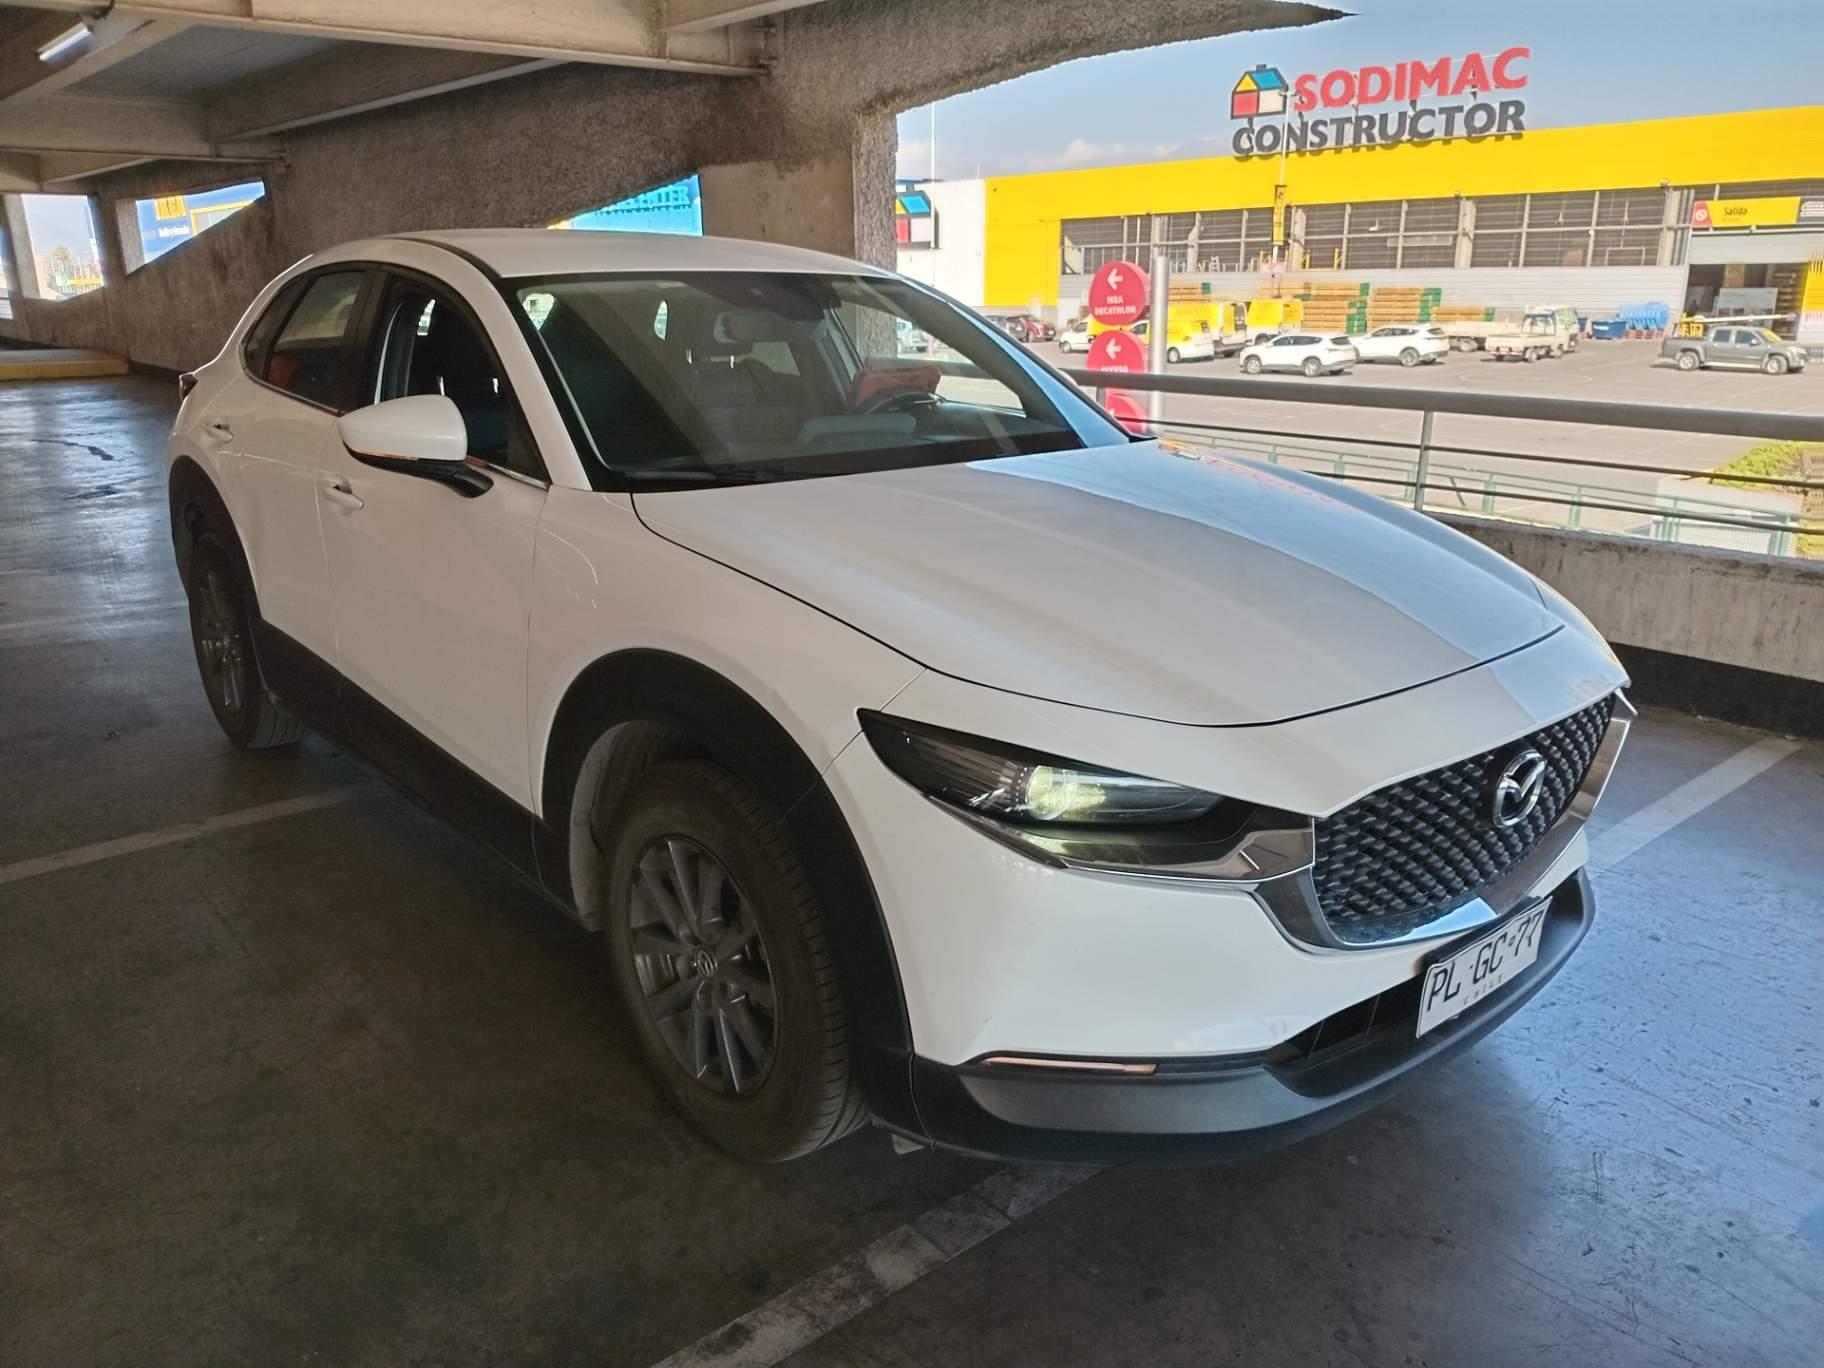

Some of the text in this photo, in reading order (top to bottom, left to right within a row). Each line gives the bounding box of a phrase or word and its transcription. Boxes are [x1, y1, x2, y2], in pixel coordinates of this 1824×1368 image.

[1294, 47, 1531, 112] SODIMAC
[1232, 99, 1526, 155] CONSTRUCTOR
[1723, 206, 1748, 216] Salida
[1094, 305, 1136, 316] DECATHLON
